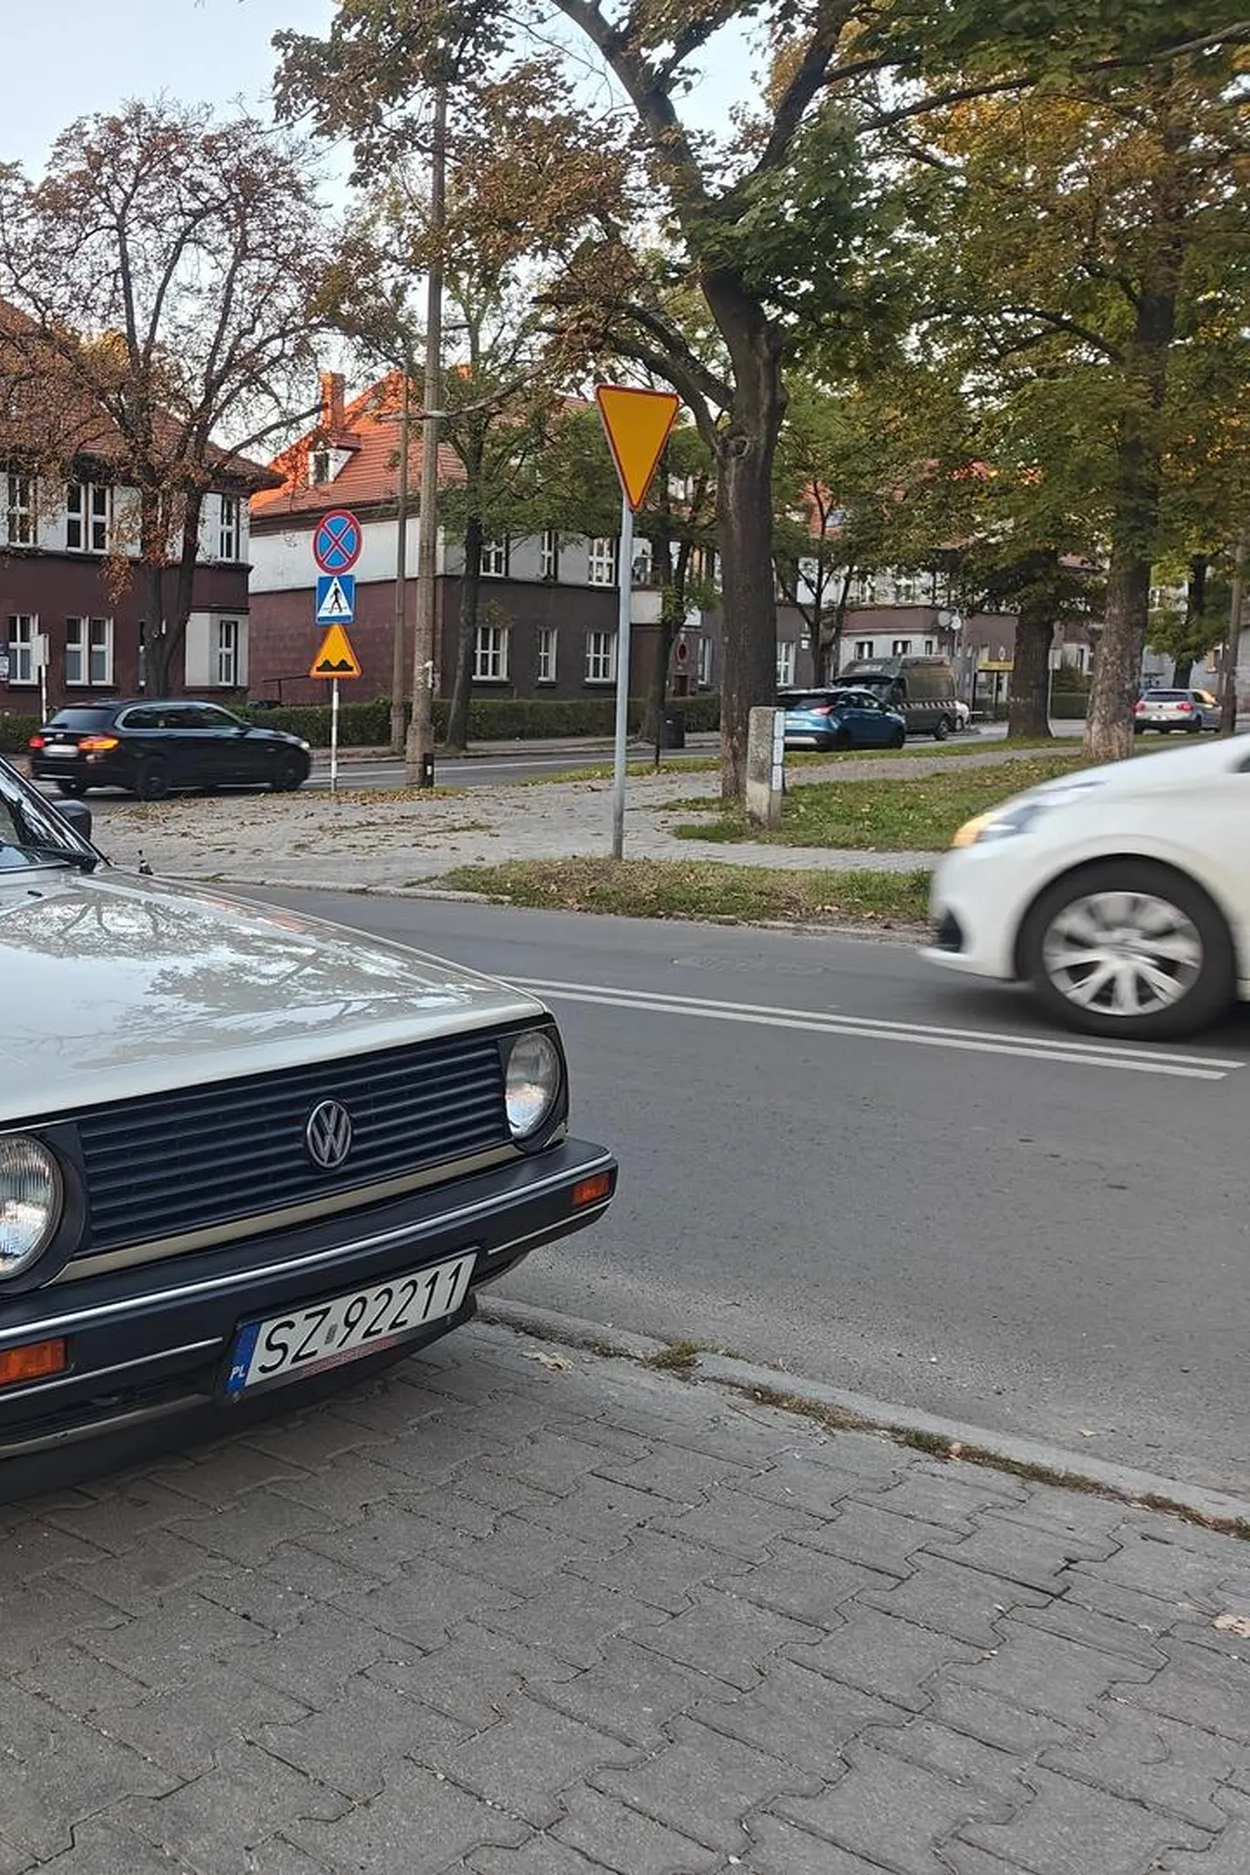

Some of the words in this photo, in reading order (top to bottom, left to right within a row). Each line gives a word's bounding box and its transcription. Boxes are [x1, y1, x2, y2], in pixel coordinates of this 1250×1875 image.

[310, 1103, 349, 1166] VW
[258, 1306, 332, 1374] SZ
[337, 1261, 464, 1348] 92211
[230, 1363, 246, 1380] PL
